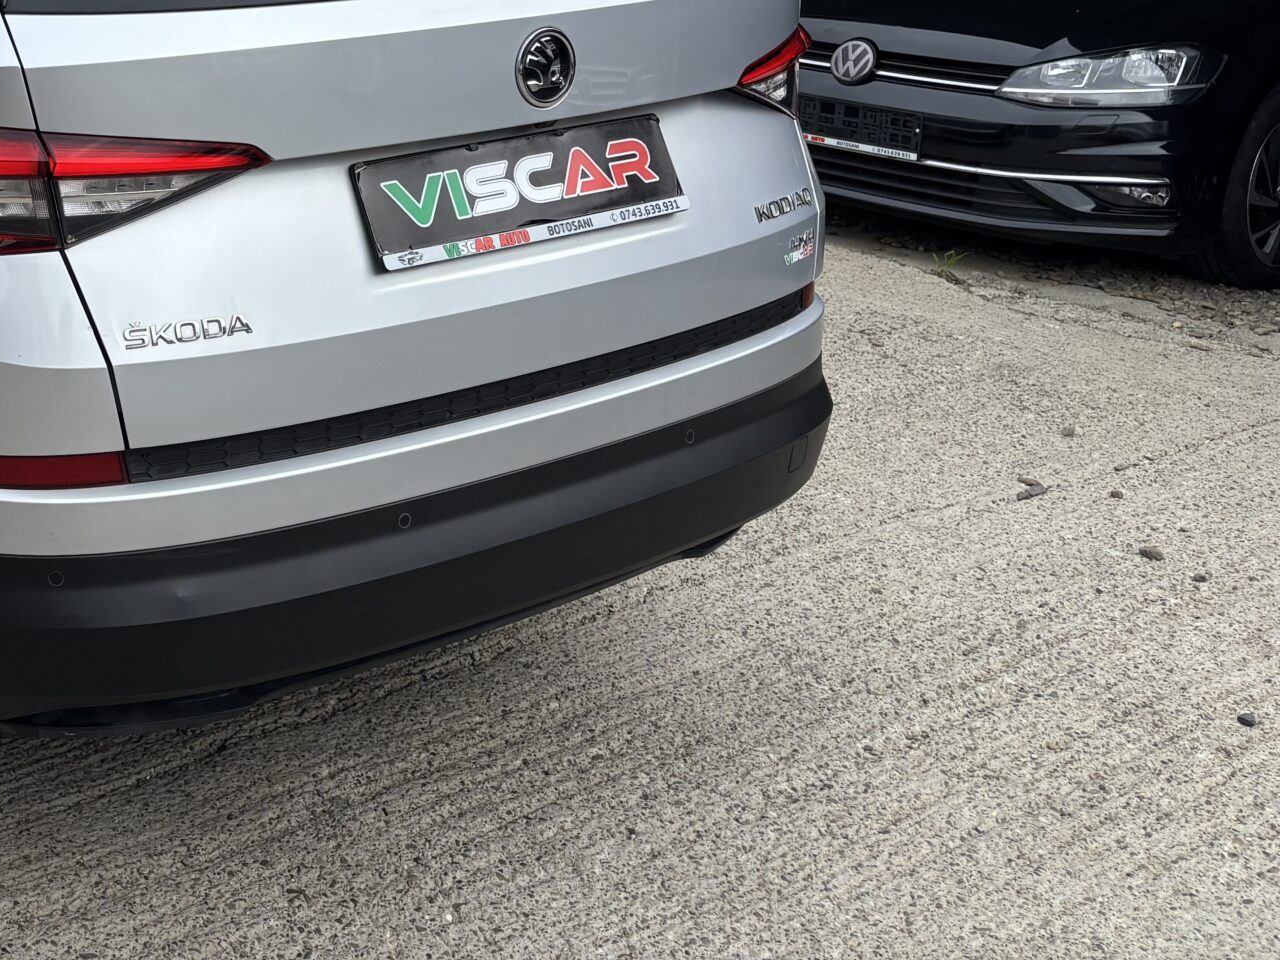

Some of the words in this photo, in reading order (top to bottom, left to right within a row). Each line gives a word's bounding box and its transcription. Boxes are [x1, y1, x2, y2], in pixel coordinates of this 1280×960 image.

[380, 138, 660, 228] VISCAR
[754, 187, 812, 224] KODIAQ
[443, 237, 495, 259] VISCAR
[499, 229, 531, 249] AUTO
[547, 217, 594, 237] BOTOSANI
[620, 200, 681, 222] 0743.639.931
[123, 313, 253, 350] ŠKODA
